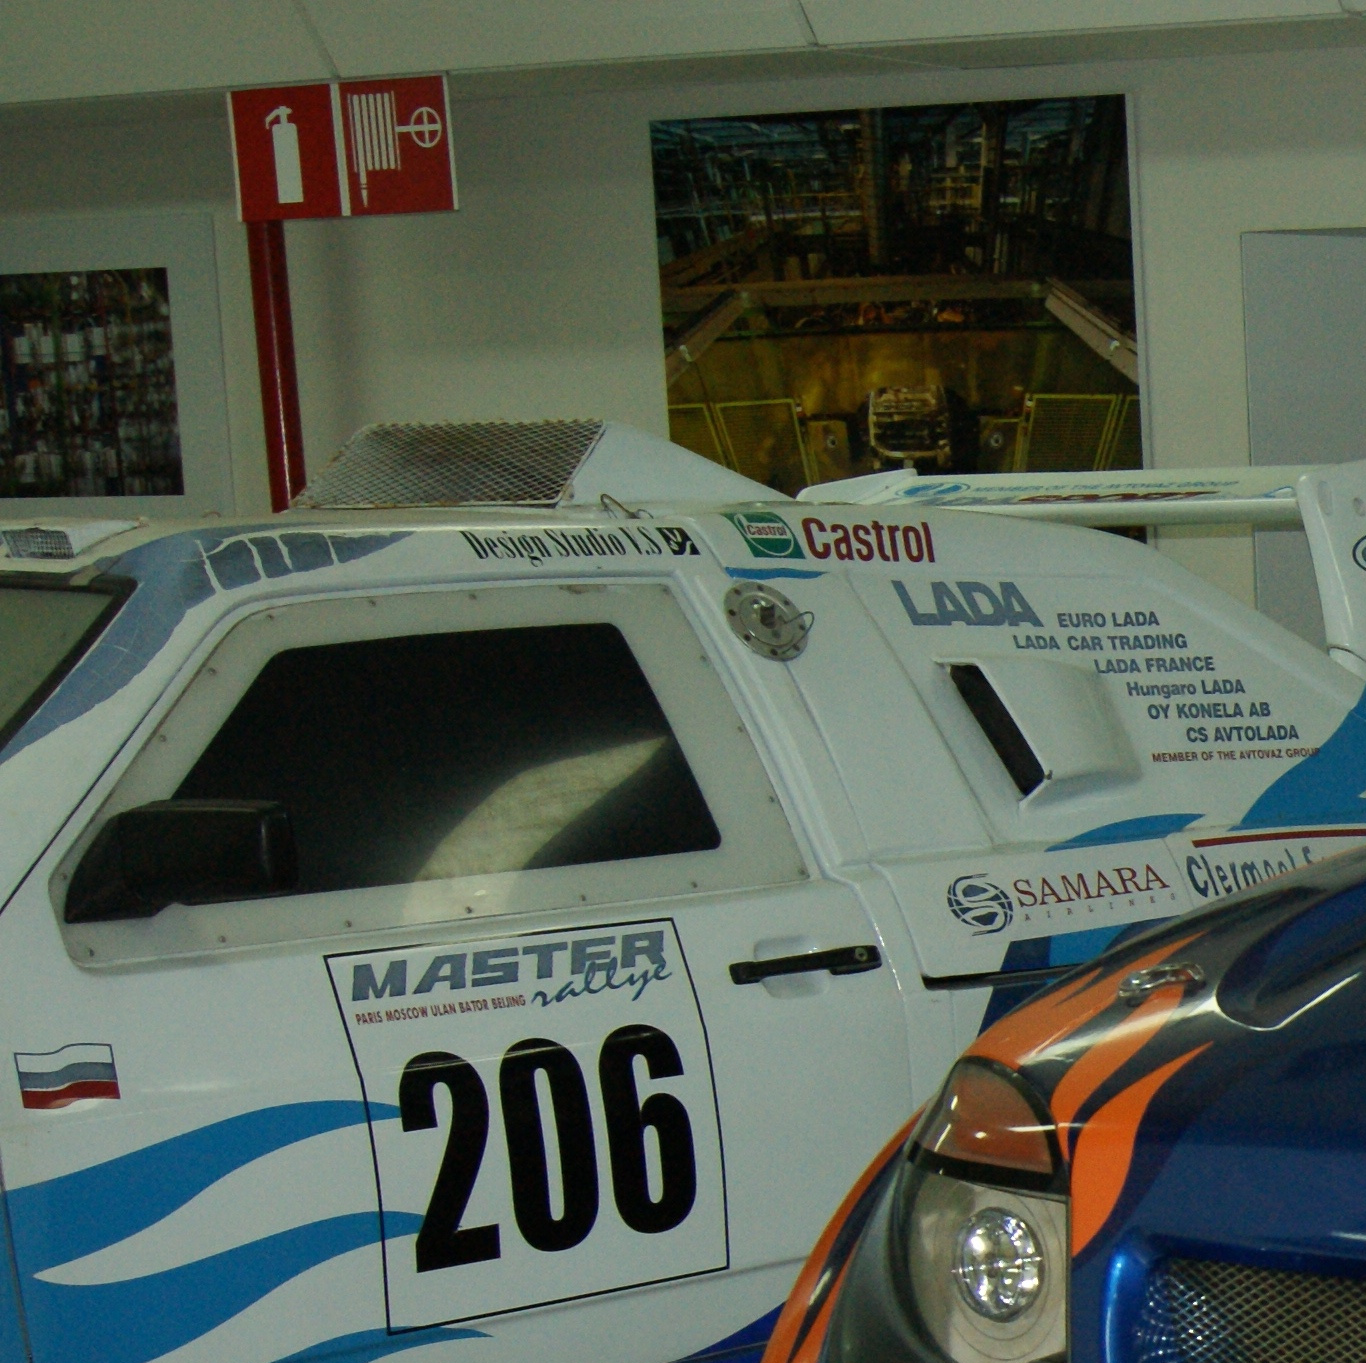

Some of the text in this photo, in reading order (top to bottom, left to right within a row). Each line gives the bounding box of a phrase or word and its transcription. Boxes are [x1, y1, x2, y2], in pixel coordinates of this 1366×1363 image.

[744, 523, 787, 538] Castrol
[801, 517, 936, 563] Castrol
[462, 529, 551, 567] Design
[552, 527, 626, 558] Studio
[891, 580, 1044, 627] LADA
[1057, 611, 1160, 628] EURO LADA
[1013, 633, 1188, 651] LADA CAR TRADING
[1094, 656, 1216, 675] LADA FRANCE
[1126, 679, 1246, 699] Hungaro LADA
[1147, 701, 1271, 720] OY KONELA AB
[1186, 725, 1300, 743] CS AVTOLADA
[1152, 747, 1321, 763] MEMBER OF THE AVTOVAZ GROUP
[1013, 864, 1171, 908] SAMARA
[352, 930, 665, 1002] MASTER
[530, 957, 673, 1008] rallye
[355, 995, 527, 1026] PARIS MOSCOW ULAN BATOR BEIJING
[398, 1024, 697, 1274] 206
